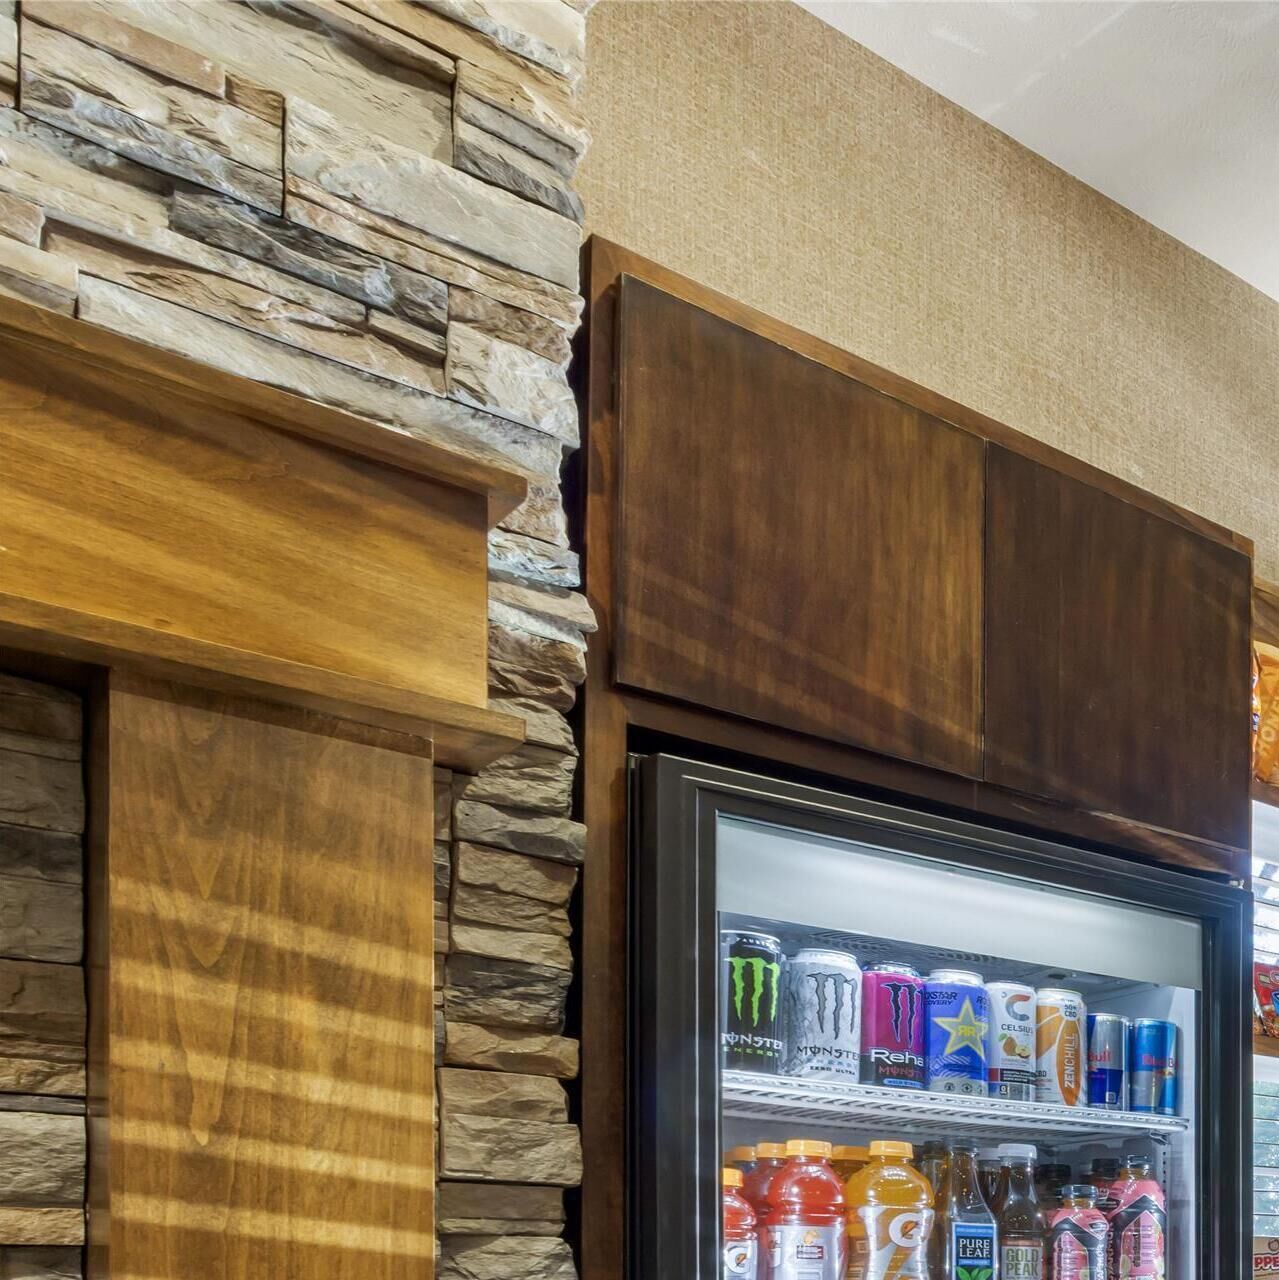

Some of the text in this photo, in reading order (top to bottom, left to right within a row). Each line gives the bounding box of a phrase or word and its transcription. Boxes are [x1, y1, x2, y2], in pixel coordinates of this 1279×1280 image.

[1064, 1034, 1076, 1089] ZENCHILL
[959, 1238, 990, 1248] PURE
[959, 1248, 991, 1258] LEAF
[1006, 1248, 1039, 1262] GOLD
[1006, 1262, 1038, 1276] PEAK
